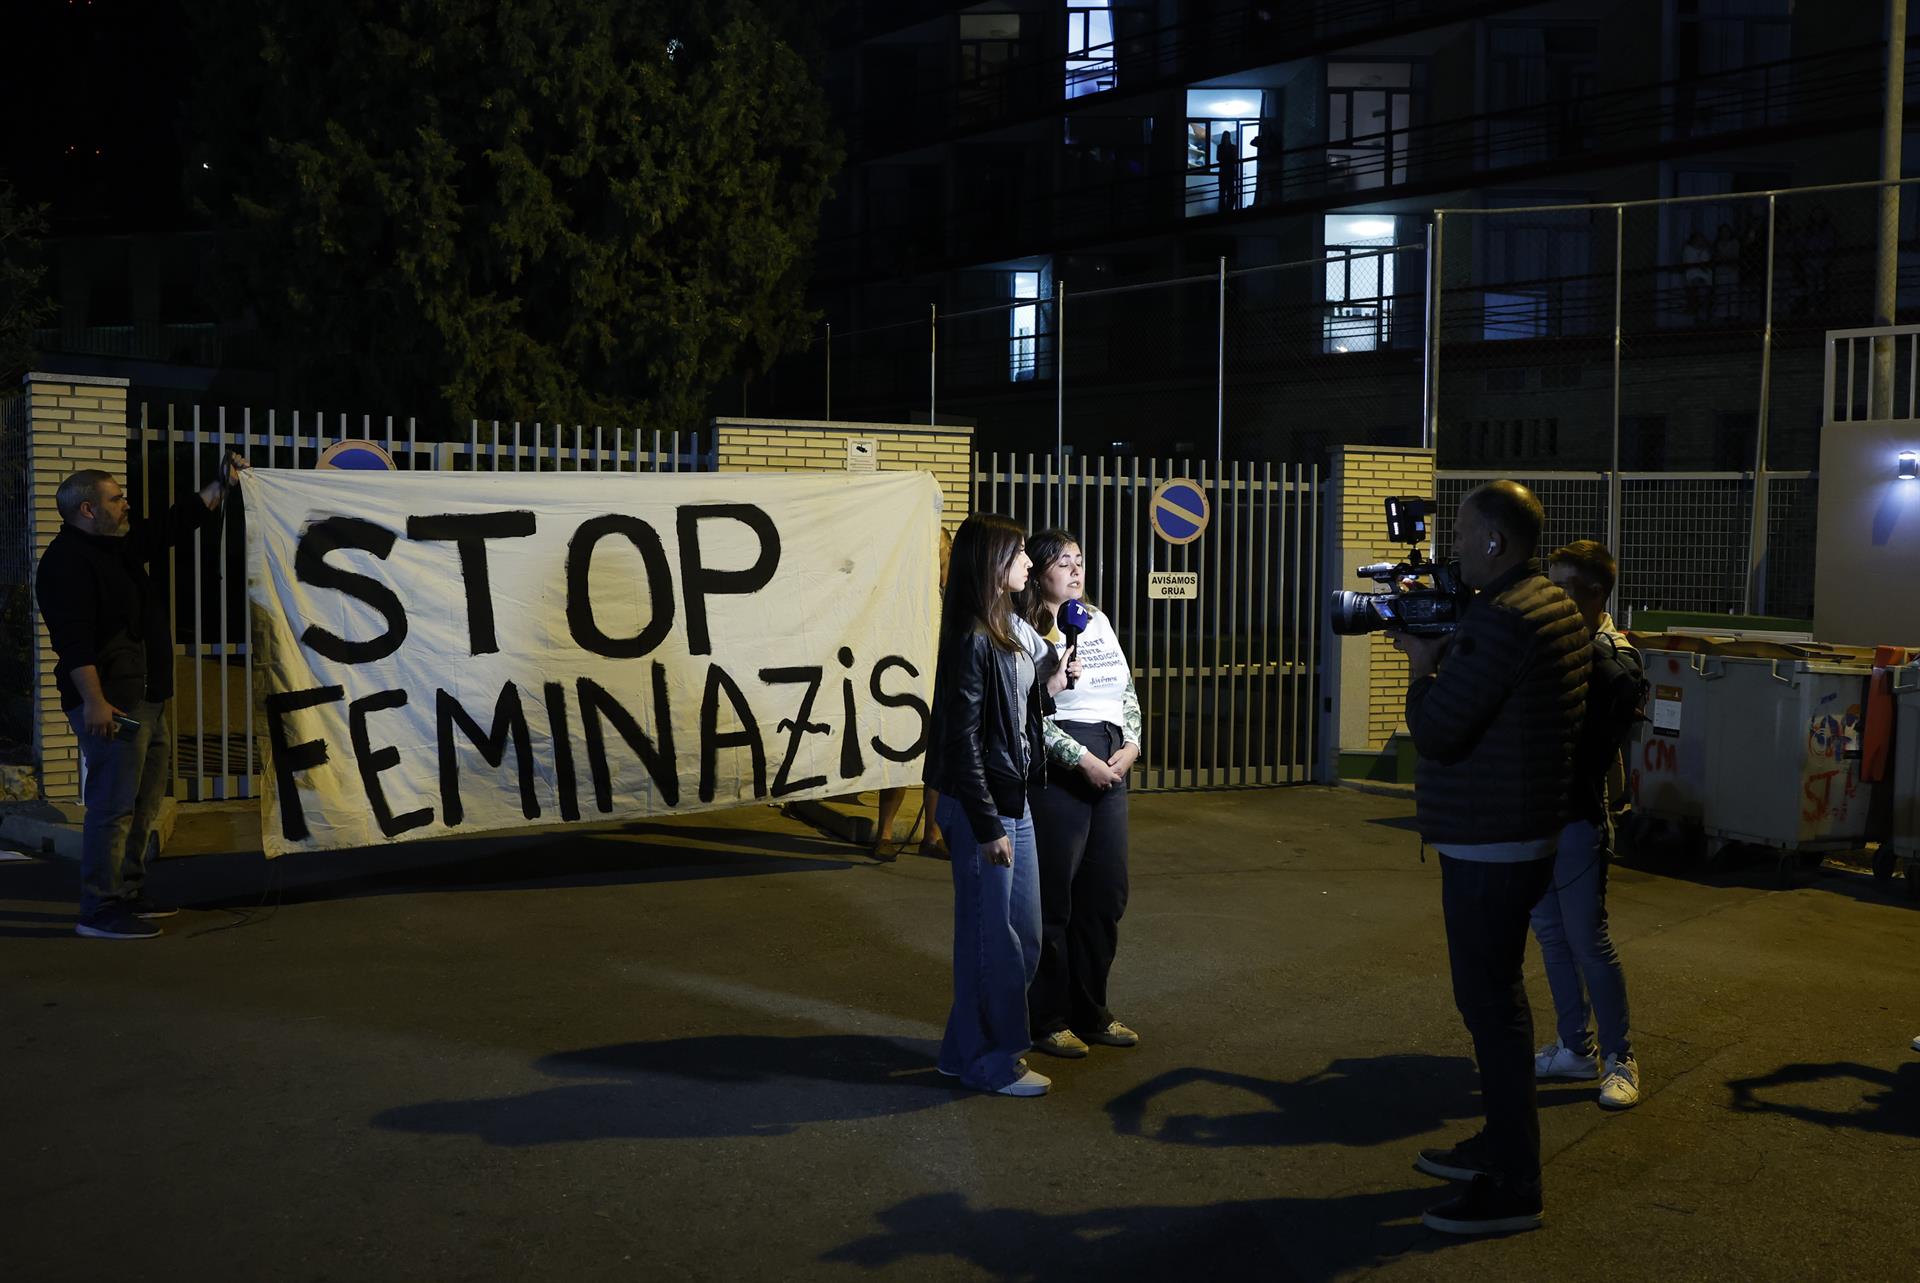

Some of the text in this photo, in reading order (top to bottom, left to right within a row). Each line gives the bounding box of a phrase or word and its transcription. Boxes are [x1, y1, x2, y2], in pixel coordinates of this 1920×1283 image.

[298, 504, 781, 664] STOP
[1151, 576, 1196, 585] AVISAMOS
[1084, 637, 1105, 648] DATE
[1076, 648, 1103, 657] UENTA
